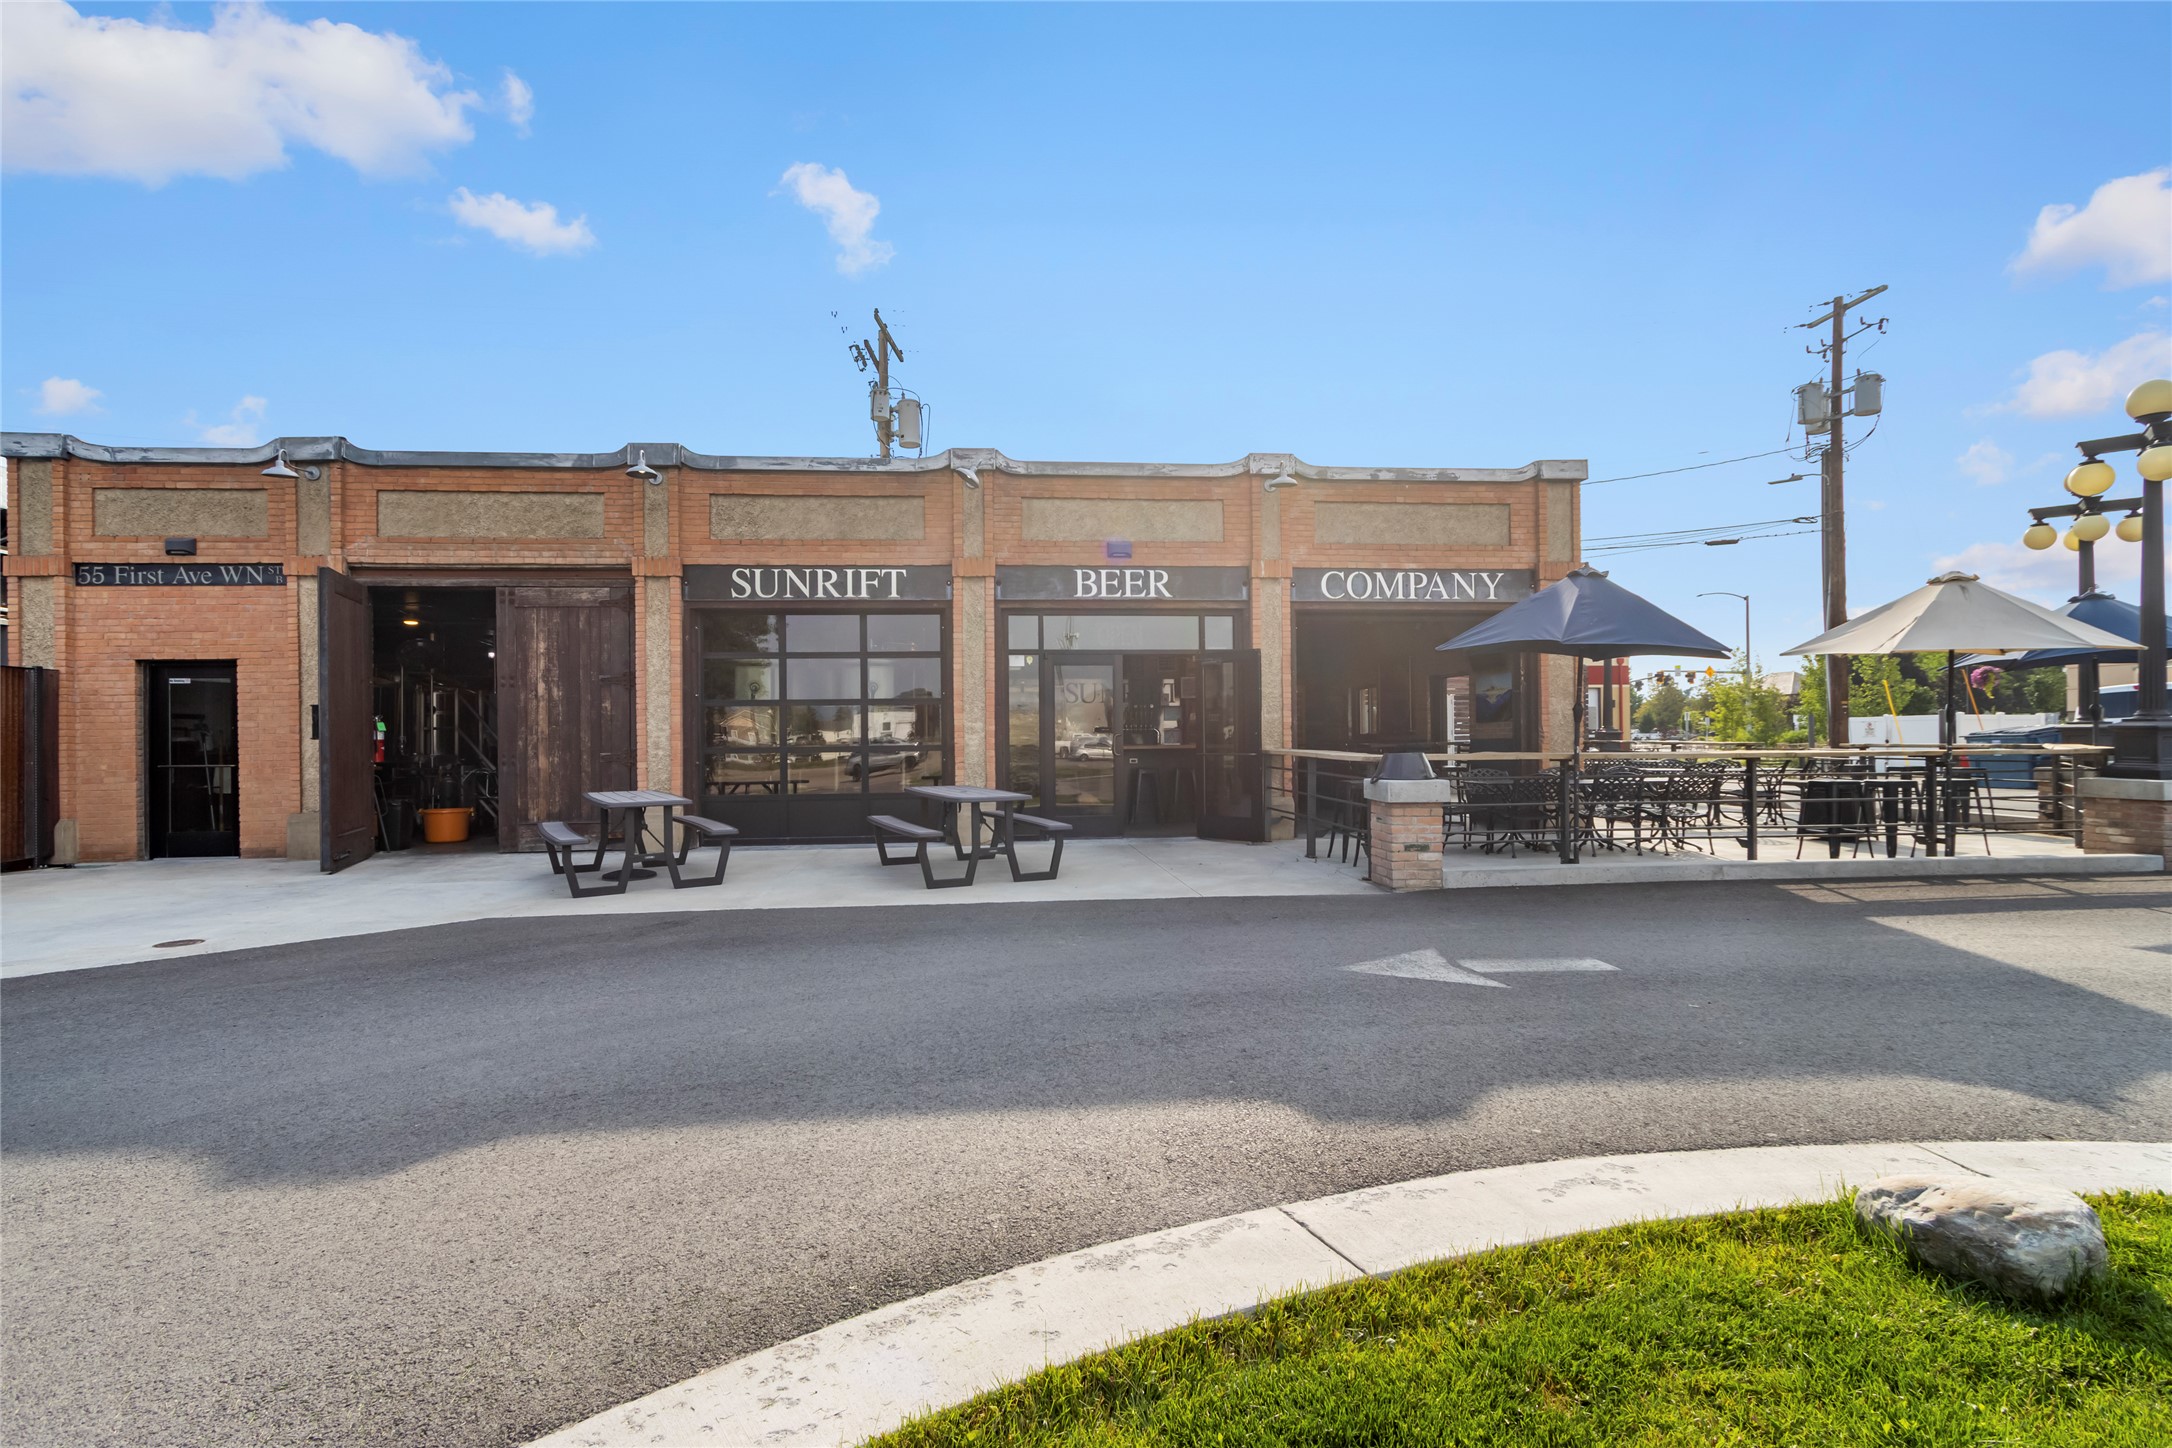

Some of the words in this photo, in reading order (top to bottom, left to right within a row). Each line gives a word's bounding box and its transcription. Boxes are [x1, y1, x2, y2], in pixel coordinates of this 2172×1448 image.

[78, 566, 105, 584] 55
[113, 566, 164, 584] First
[172, 566, 212, 584] Ave
[731, 567, 907, 599] SUNRIFT
[1073, 568, 1174, 598] BEER
[1320, 570, 1505, 600] COMPANY
